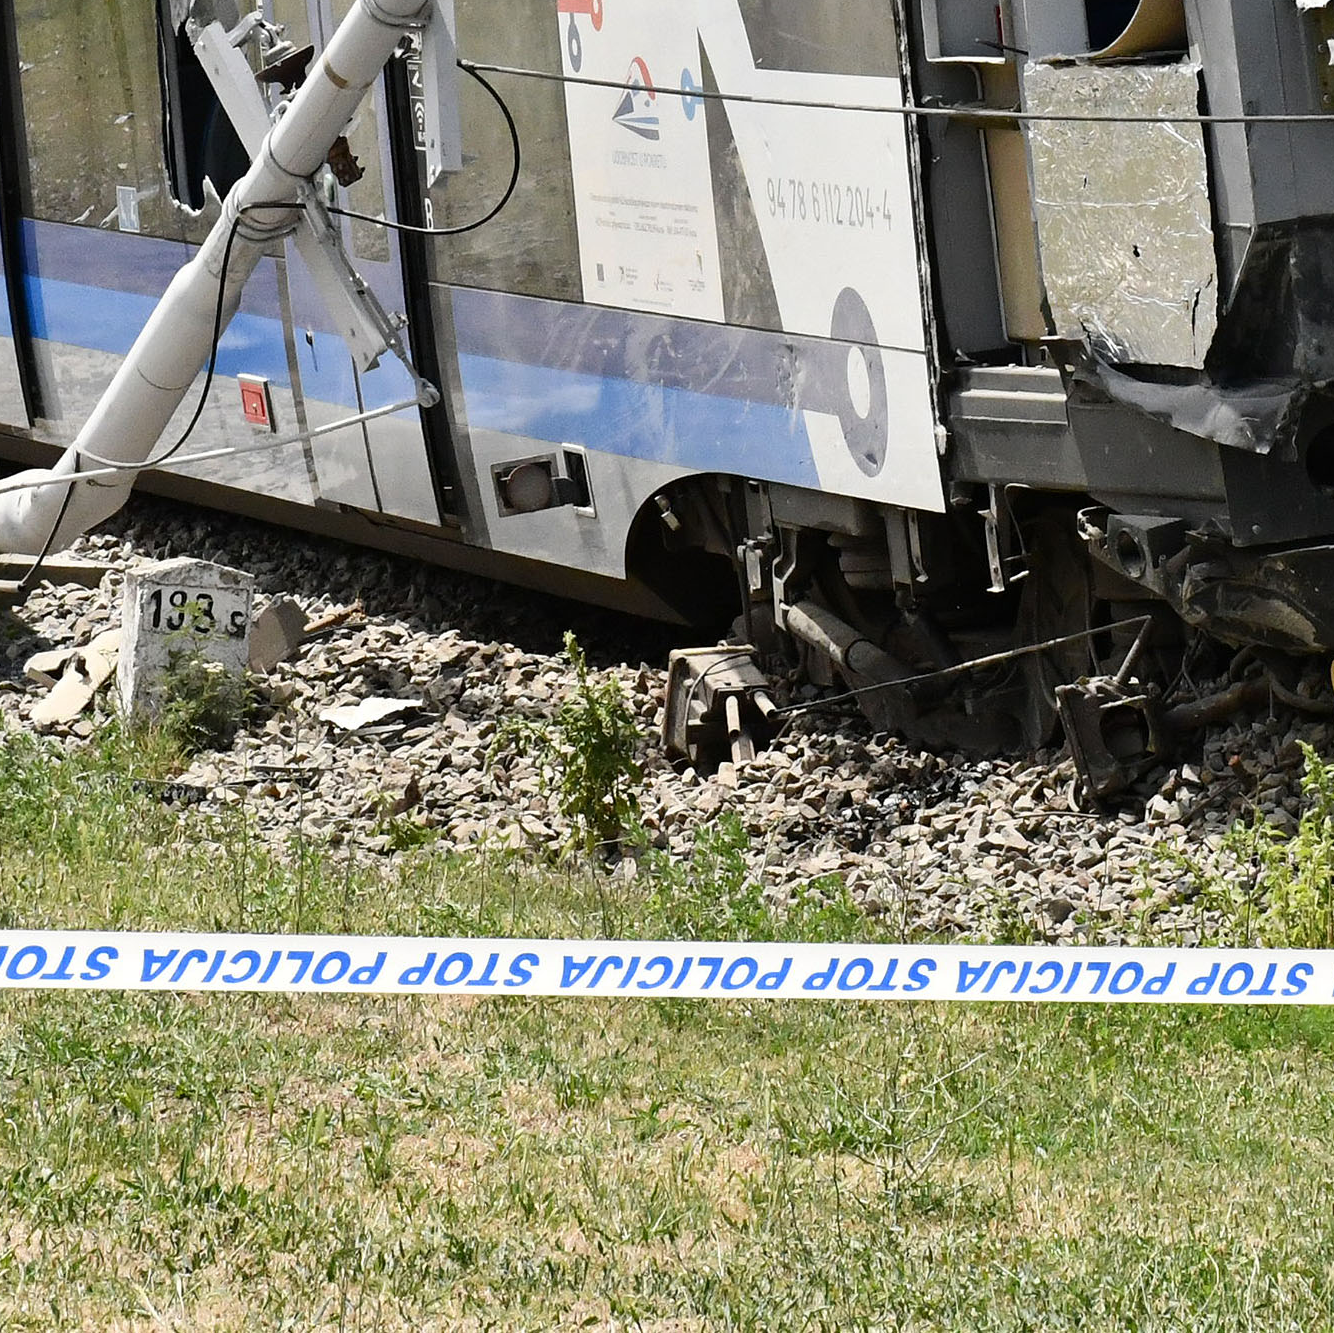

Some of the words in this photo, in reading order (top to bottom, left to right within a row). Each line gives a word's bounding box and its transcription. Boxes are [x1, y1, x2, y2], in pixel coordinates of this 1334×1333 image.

[767, 178, 786, 218] 94
[788, 179, 807, 221] 78
[846, 185, 892, 231] 204-4
[141, 950, 387, 984] POLICIJA
[399, 952, 539, 986] STOP
[561, 956, 793, 990] POLICIJA
[803, 958, 937, 991] STOP
[957, 961, 1176, 994] POLICIJA
[1187, 963, 1314, 996] STOP
